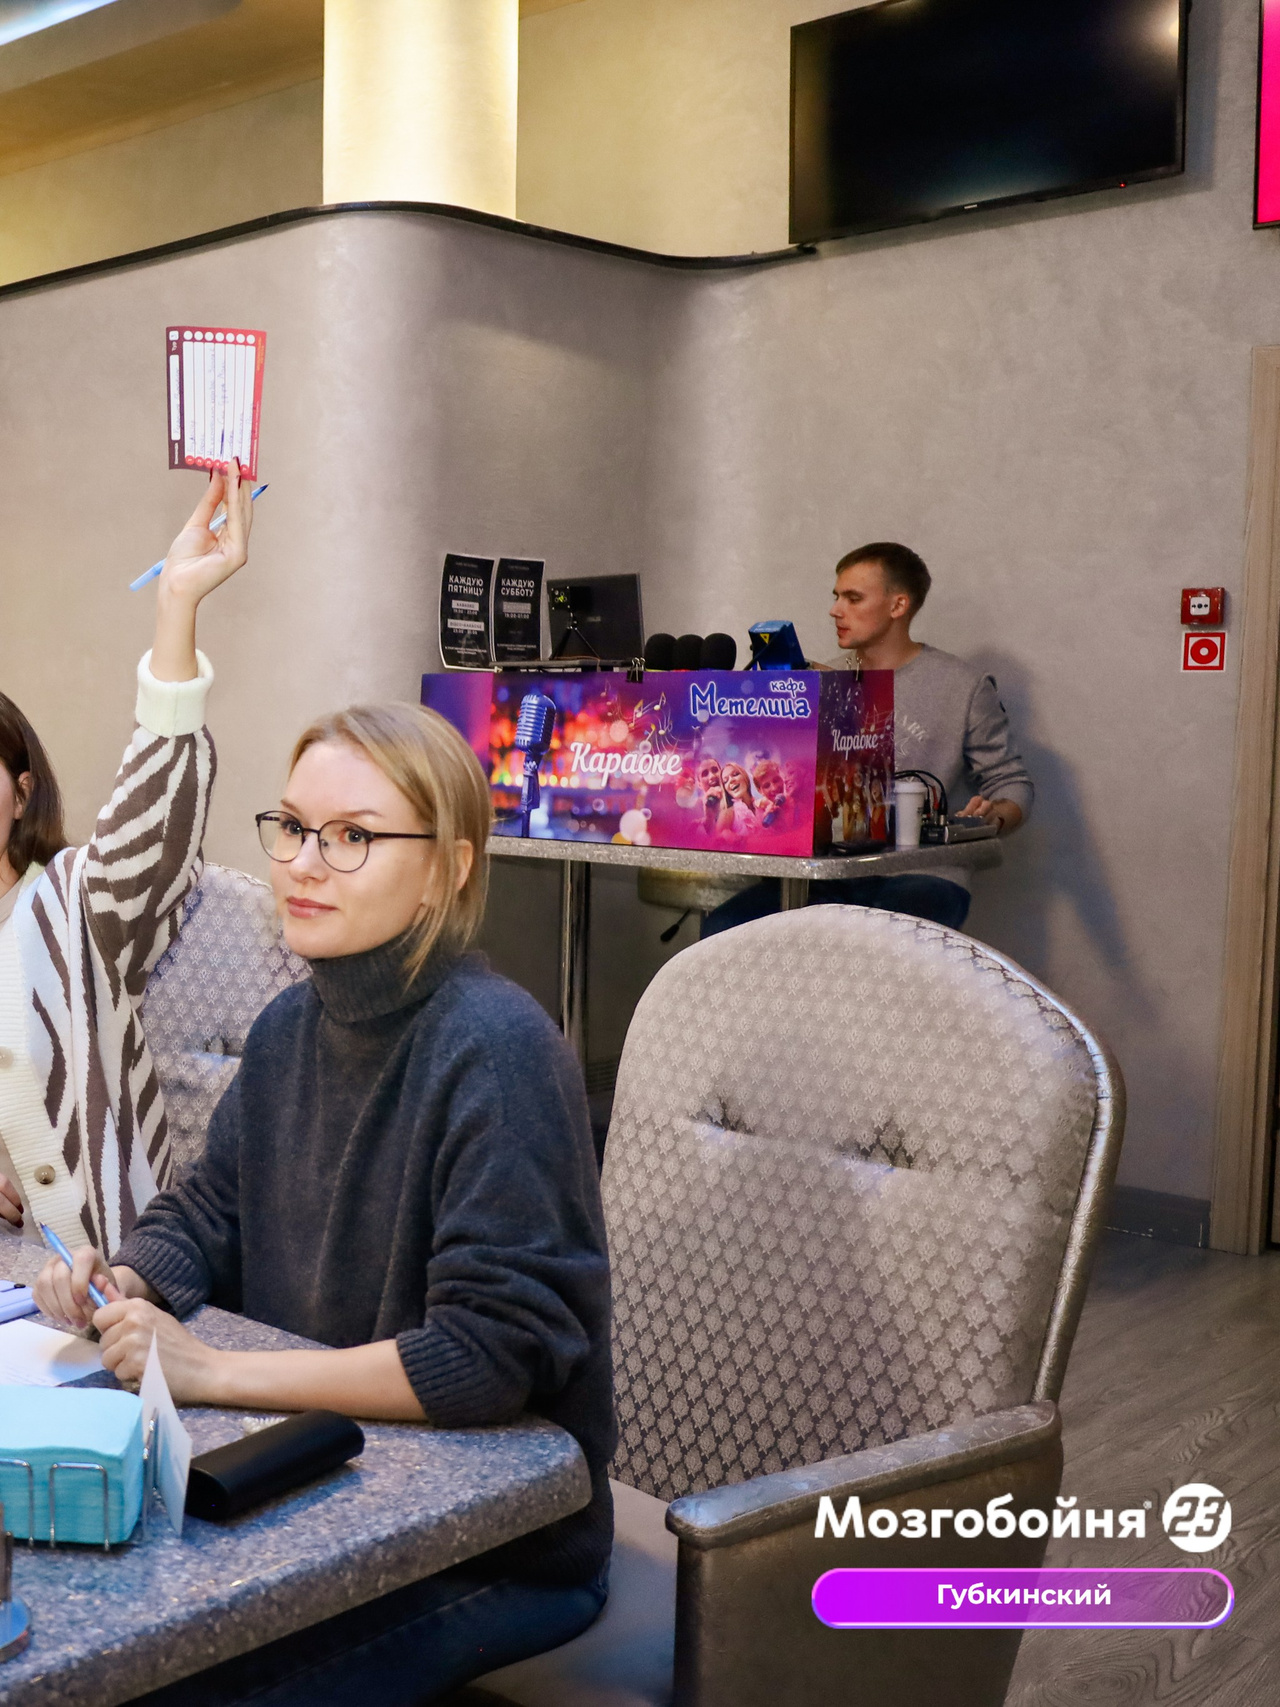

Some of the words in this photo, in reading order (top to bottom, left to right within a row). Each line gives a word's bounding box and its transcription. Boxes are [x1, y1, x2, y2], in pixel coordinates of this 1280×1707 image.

[449, 575, 484, 587] КАЖДУЮ
[501, 578, 535, 588] КАЖДУЮ
[448, 584, 484, 596] ПЯТНИЦУ
[501, 587, 534, 597] СУББОТУ
[770, 678, 807, 698] кафе
[689, 681, 812, 719] Метелица
[831, 729, 879, 760] Караоке
[570, 741, 683, 788] Караоке
